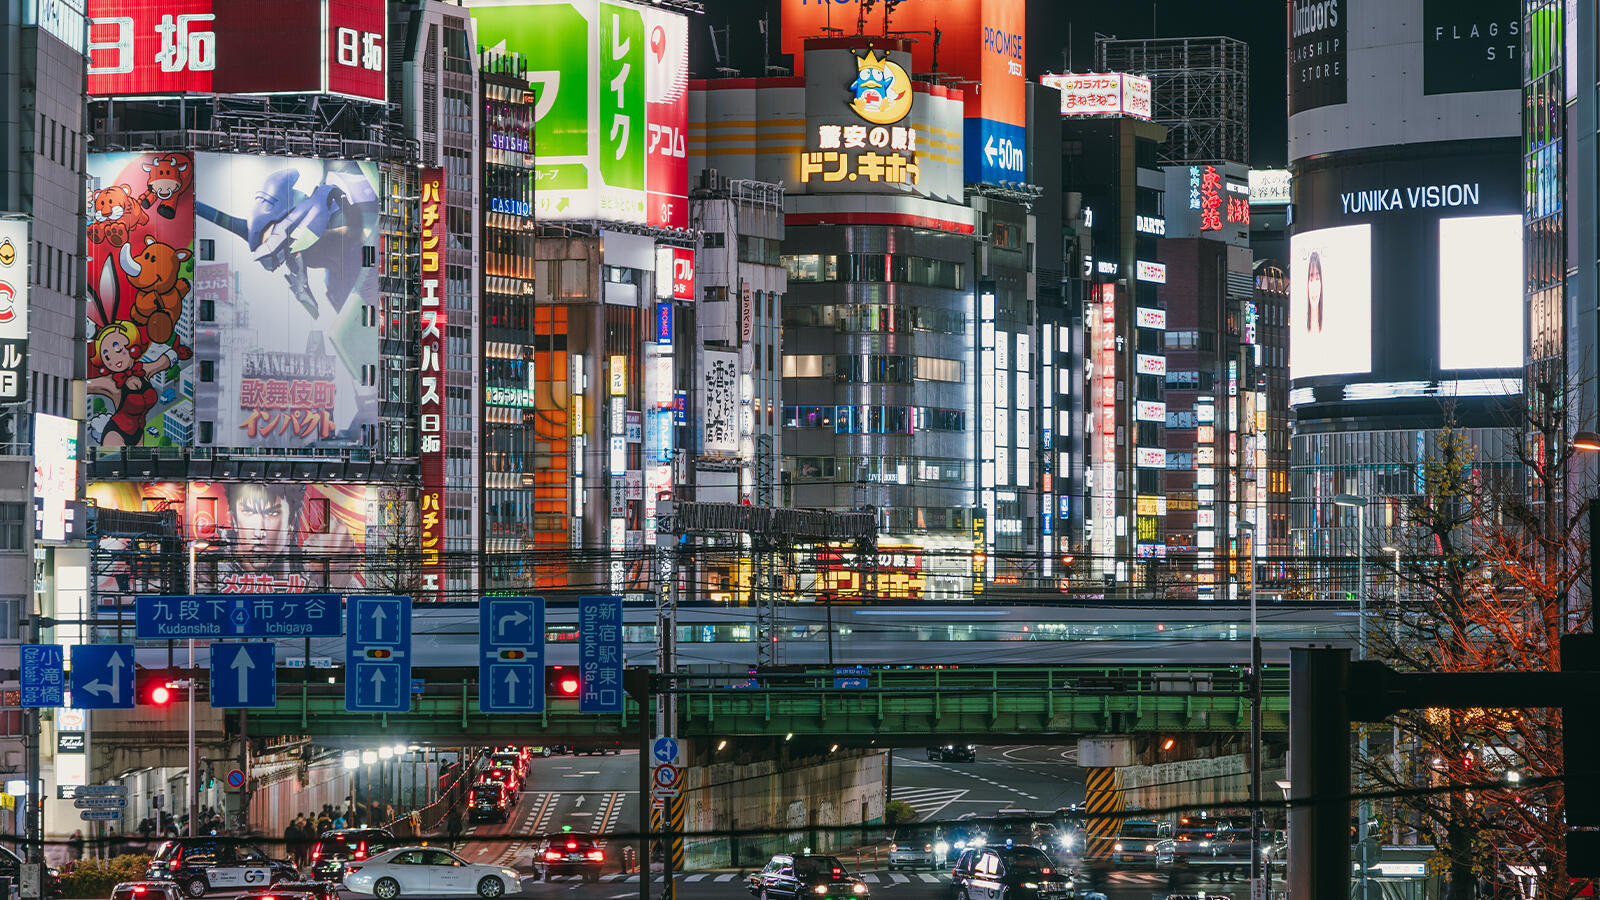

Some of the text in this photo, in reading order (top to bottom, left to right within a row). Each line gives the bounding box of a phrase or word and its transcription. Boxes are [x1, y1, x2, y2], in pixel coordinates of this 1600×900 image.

[1292, 0, 1338, 38] Outdoors
[338, 26, 382, 72] 日拓
[984, 26, 1023, 61] PROMISE
[1007, 60, 1023, 77] プロミス
[1302, 61, 1340, 83] STORE
[610, 13, 631, 161] レイク
[1073, 79, 1111, 90] カラオケ
[1066, 93, 1117, 109] まねきねこ
[492, 132, 529, 153] SHISHA
[648, 122, 686, 158] アコム
[998, 138, 1024, 173] 50m
[492, 197, 530, 217] CASINO
[1341, 183, 1480, 214] YUNIKA VISION
[660, 203, 674, 223] 3F
[1136, 215, 1166, 236] DARTS
[240, 378, 336, 409] 歌舞伎町
[239, 407, 336, 438] インパクト
[222, 572, 308, 594] メガホール
[152, 600, 227, 621] 九段下
[235, 611, 244, 622] 4
[158, 621, 313, 634] Kudanshita Ichigaya
[584, 605, 598, 658] Shinjuku
[598, 602, 617, 706] 新宿駅東口
[40, 648, 61, 703] 小滝橋
[244, 870, 265, 883] GO
